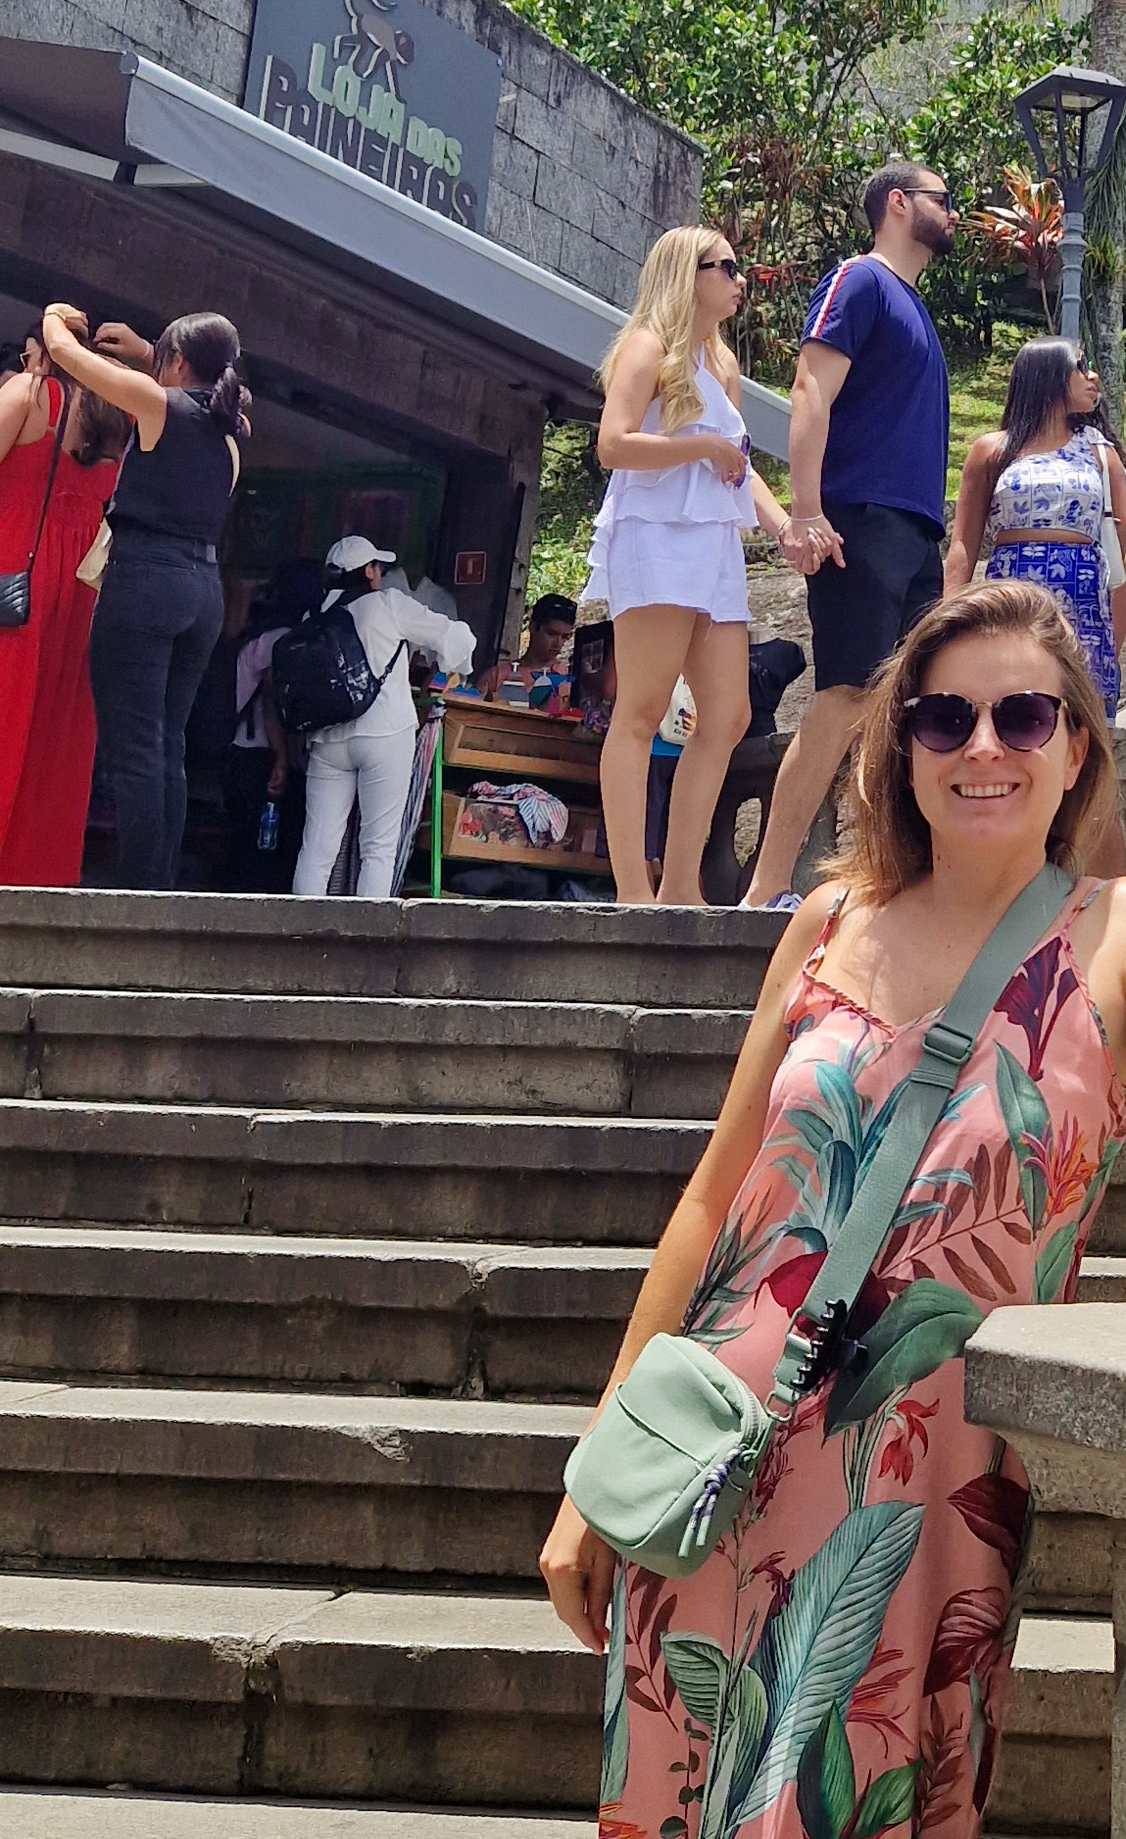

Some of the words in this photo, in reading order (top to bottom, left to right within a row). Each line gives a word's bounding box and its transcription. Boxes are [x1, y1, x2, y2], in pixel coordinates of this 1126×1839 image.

[259, 54, 477, 231] PAINEIRAS
[308, 42, 403, 147] LOJA
[406, 115, 462, 176] DAS
